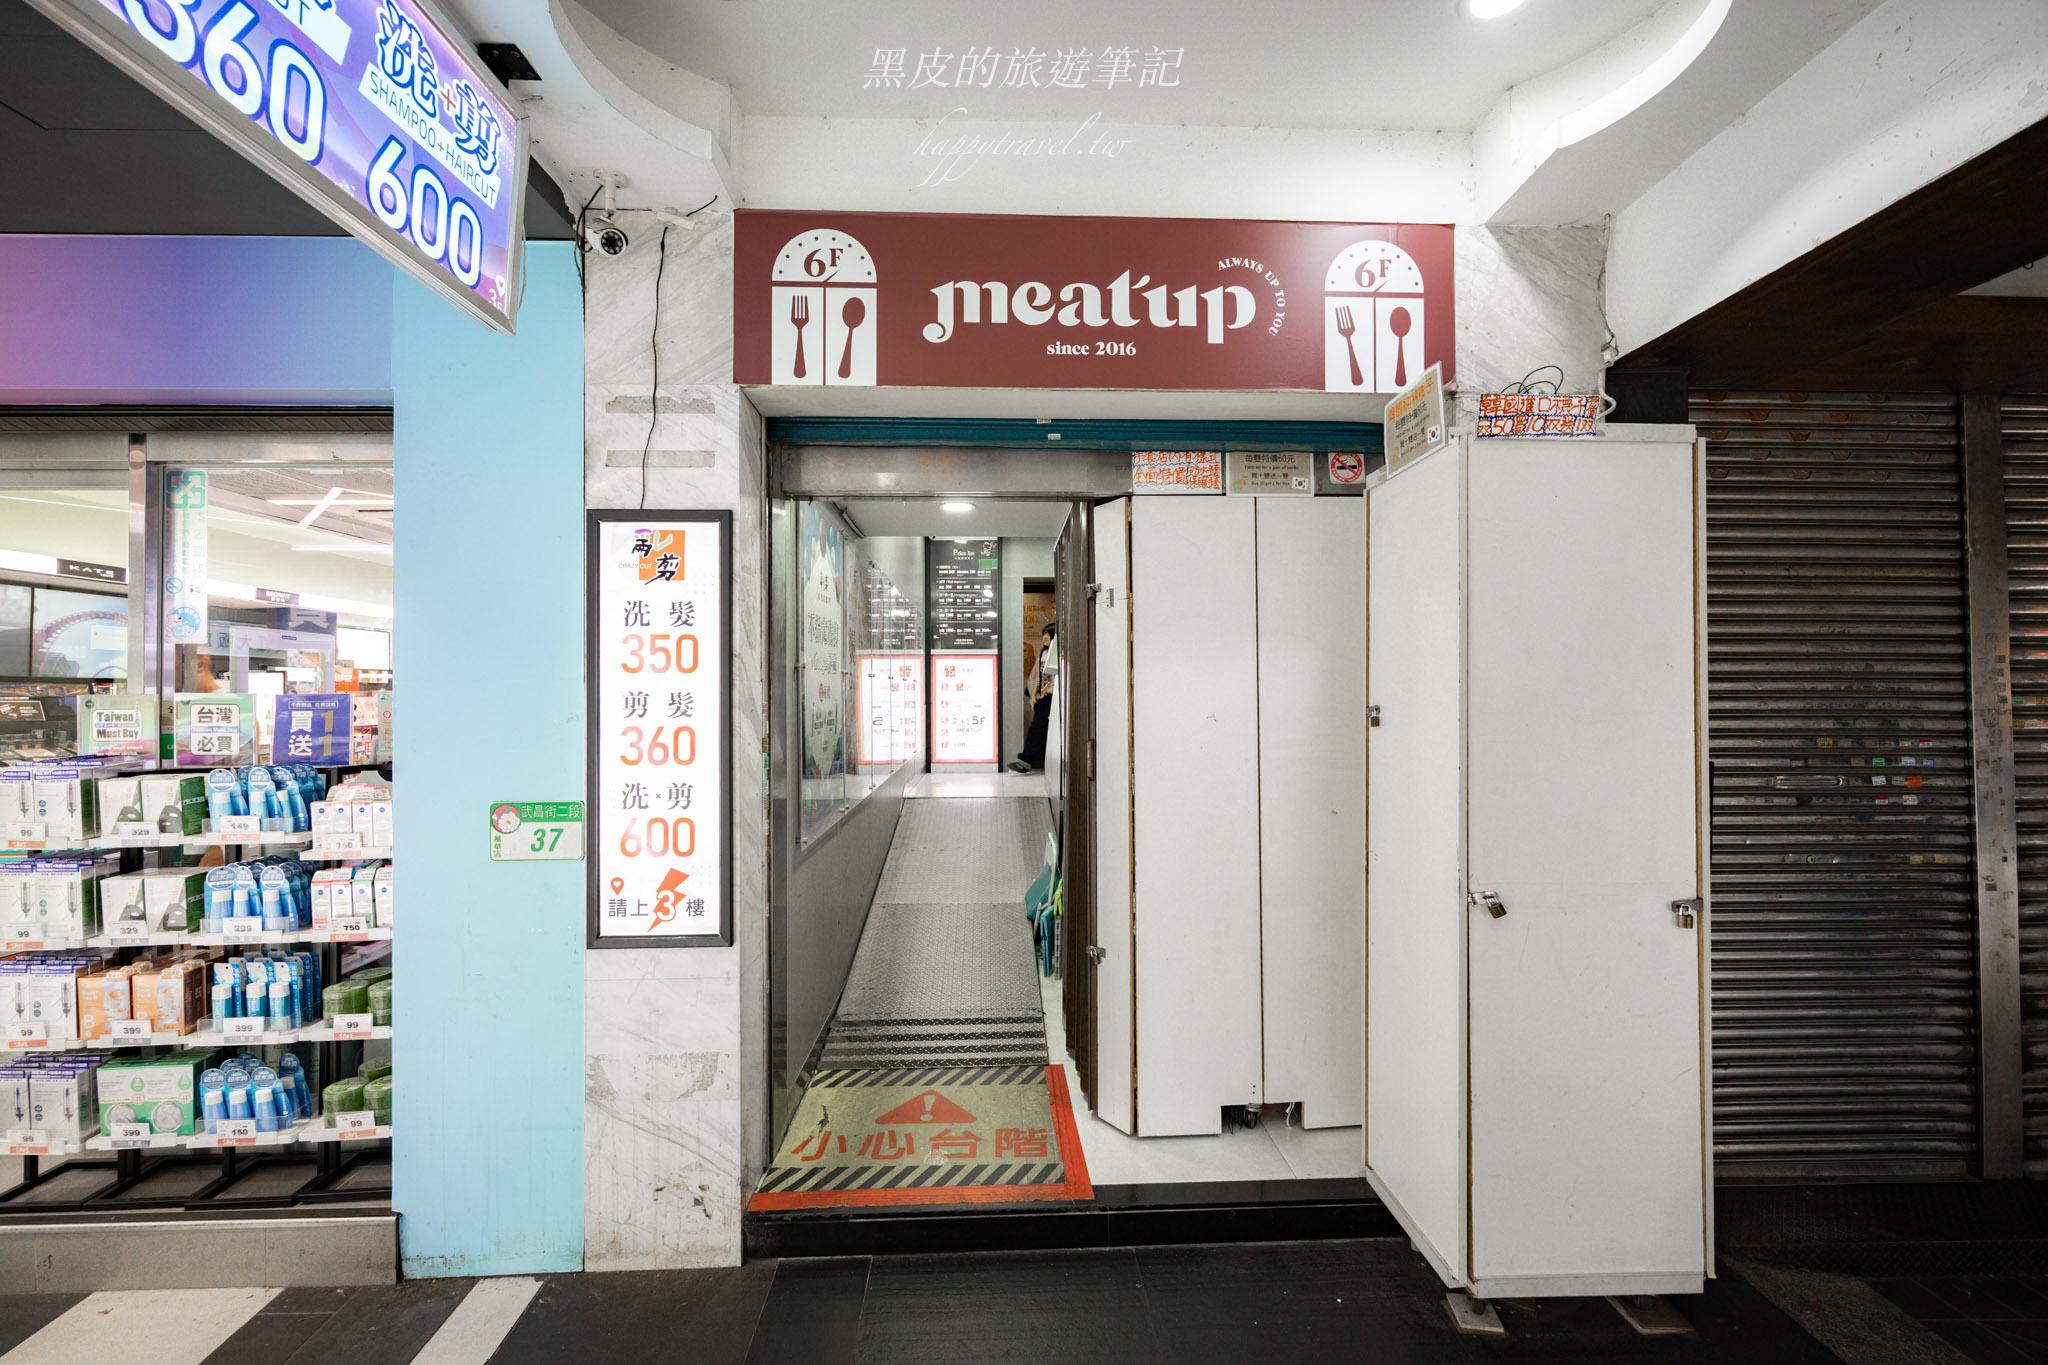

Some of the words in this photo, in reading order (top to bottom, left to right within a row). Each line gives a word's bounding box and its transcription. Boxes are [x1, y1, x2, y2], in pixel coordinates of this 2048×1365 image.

[365, 134, 483, 289] 600
[803, 248, 844, 278] 6F
[1218, 257, 1264, 273] ALWAYS
[1264, 270, 1280, 287] UP
[1354, 258, 1393, 288] 6F
[1275, 289, 1286, 307] TO
[1268, 311, 1286, 337] YOU
[1046, 341, 1090, 356] since
[1095, 341, 1137, 356] 2016
[623, 600, 695, 628] 洗髮
[621, 633, 699, 674] 350
[623, 690, 694, 719] 剪髮
[96, 712, 134, 722] Taiwan
[197, 706, 233, 724] 台灣
[96, 729, 121, 739] Must
[122, 729, 139, 740] Buy
[197, 736, 233, 753] 必買
[620, 725, 696, 766] 360
[520, 804, 581, 818] 武昌街二段
[530, 828, 564, 852] 37
[620, 817, 696, 858] 600
[17, 930, 30, 938] 99
[119, 927, 139, 935] 329
[20, 1029, 33, 1037] 99
[122, 1027, 142, 1035] 399
[234, 1024, 253, 1032] 399
[346, 1021, 359, 1029] 99
[350, 1119, 363, 1127] 99
[122, 1129, 141, 1137] 399
[231, 1128, 249, 1136] 150
[791, 1126, 1048, 1162] 小心台階
